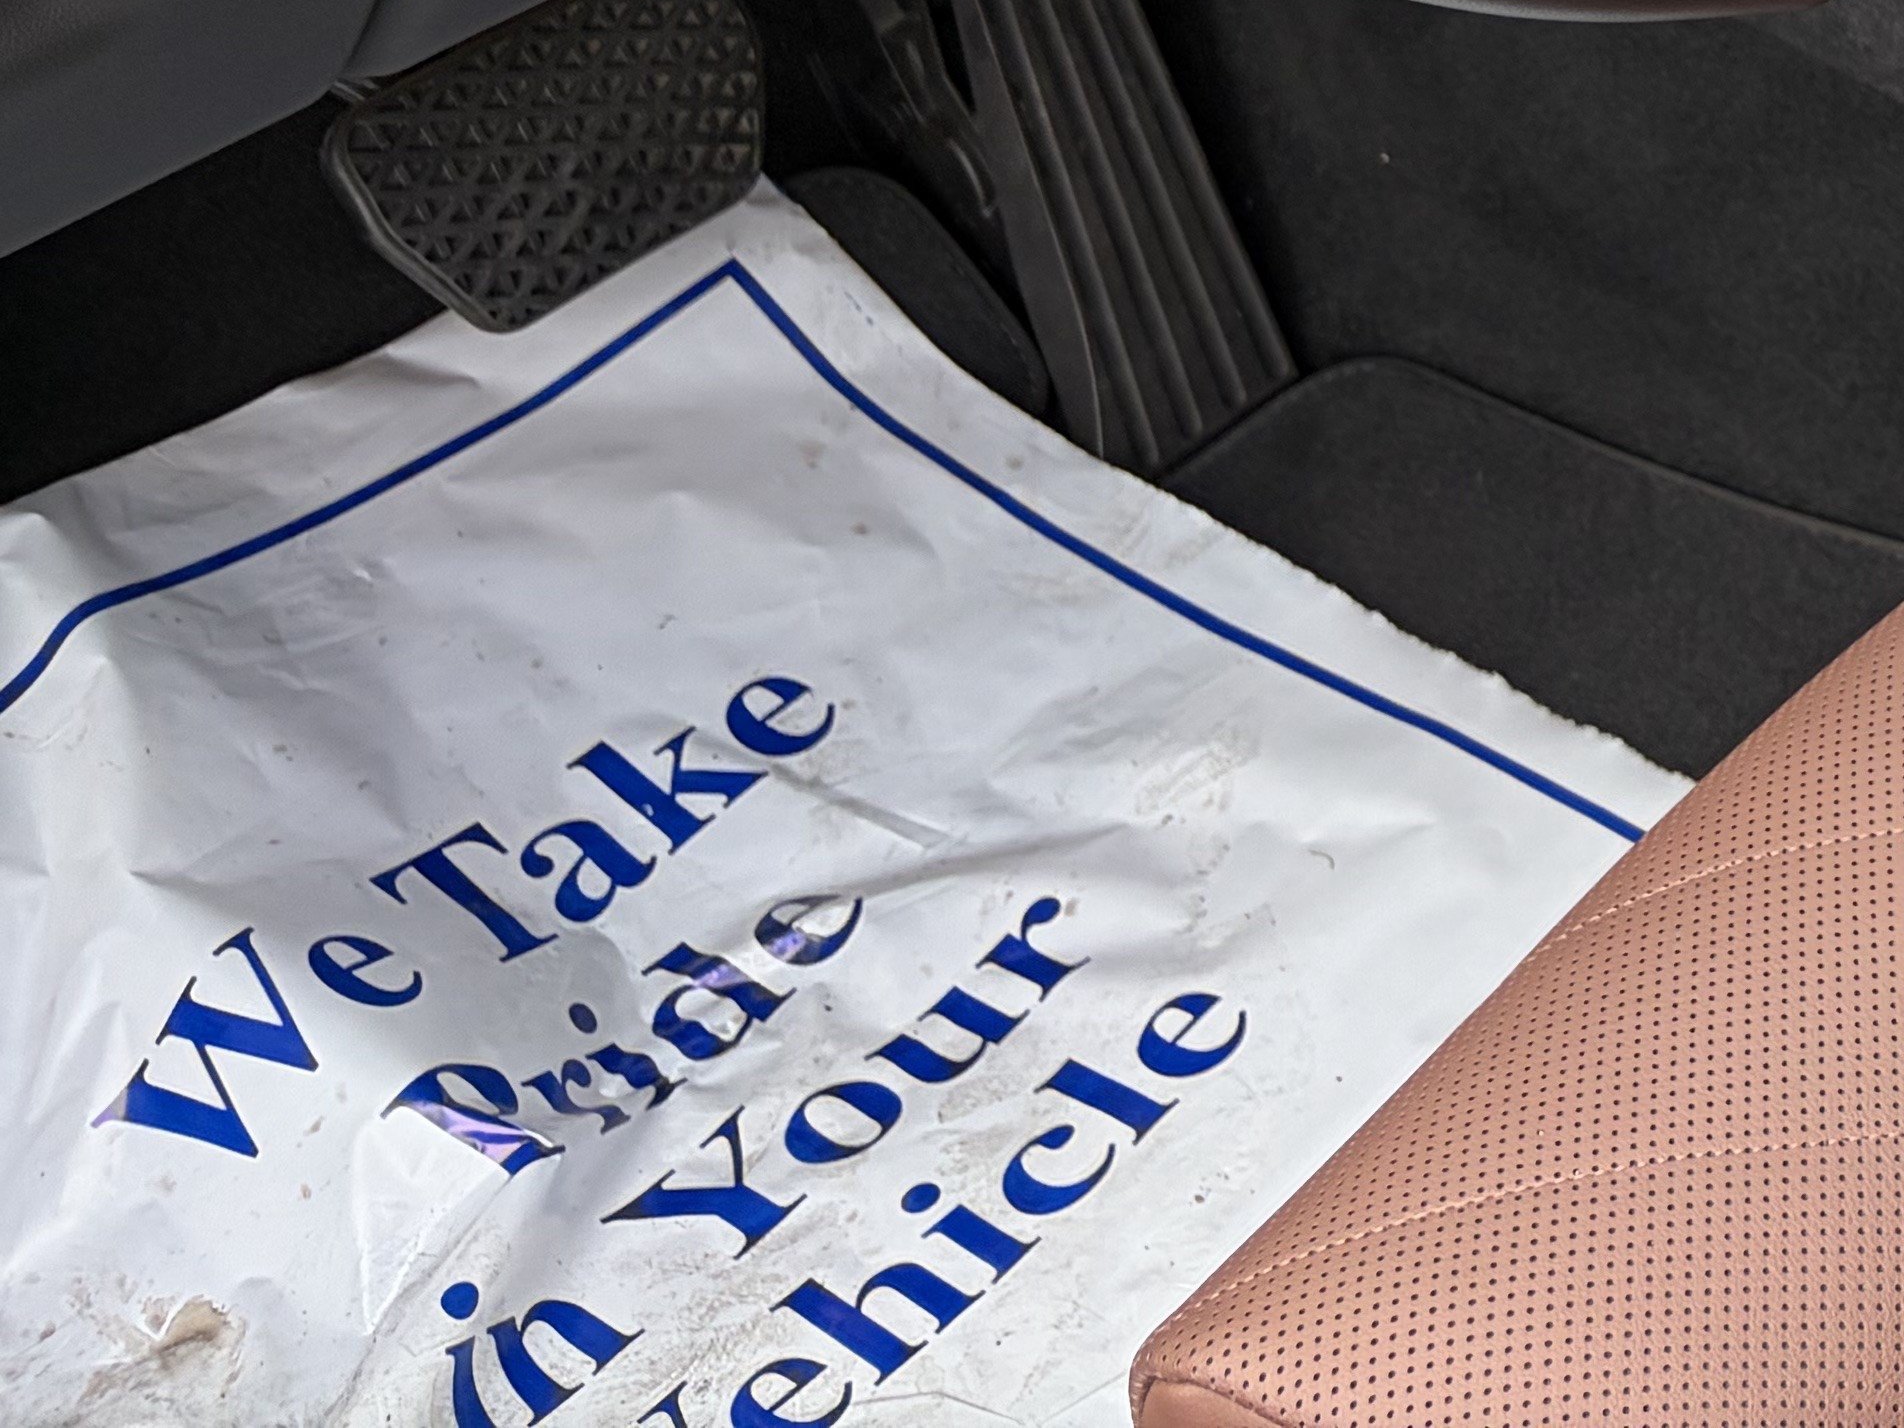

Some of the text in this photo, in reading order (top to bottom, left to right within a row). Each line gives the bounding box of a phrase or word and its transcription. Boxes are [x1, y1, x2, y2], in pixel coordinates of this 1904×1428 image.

[91, 676, 836, 1158] We Take
[380, 894, 864, 1176] Pride
[440, 897, 1091, 1428] in Your
[636, 992, 1247, 1428] ehicle
